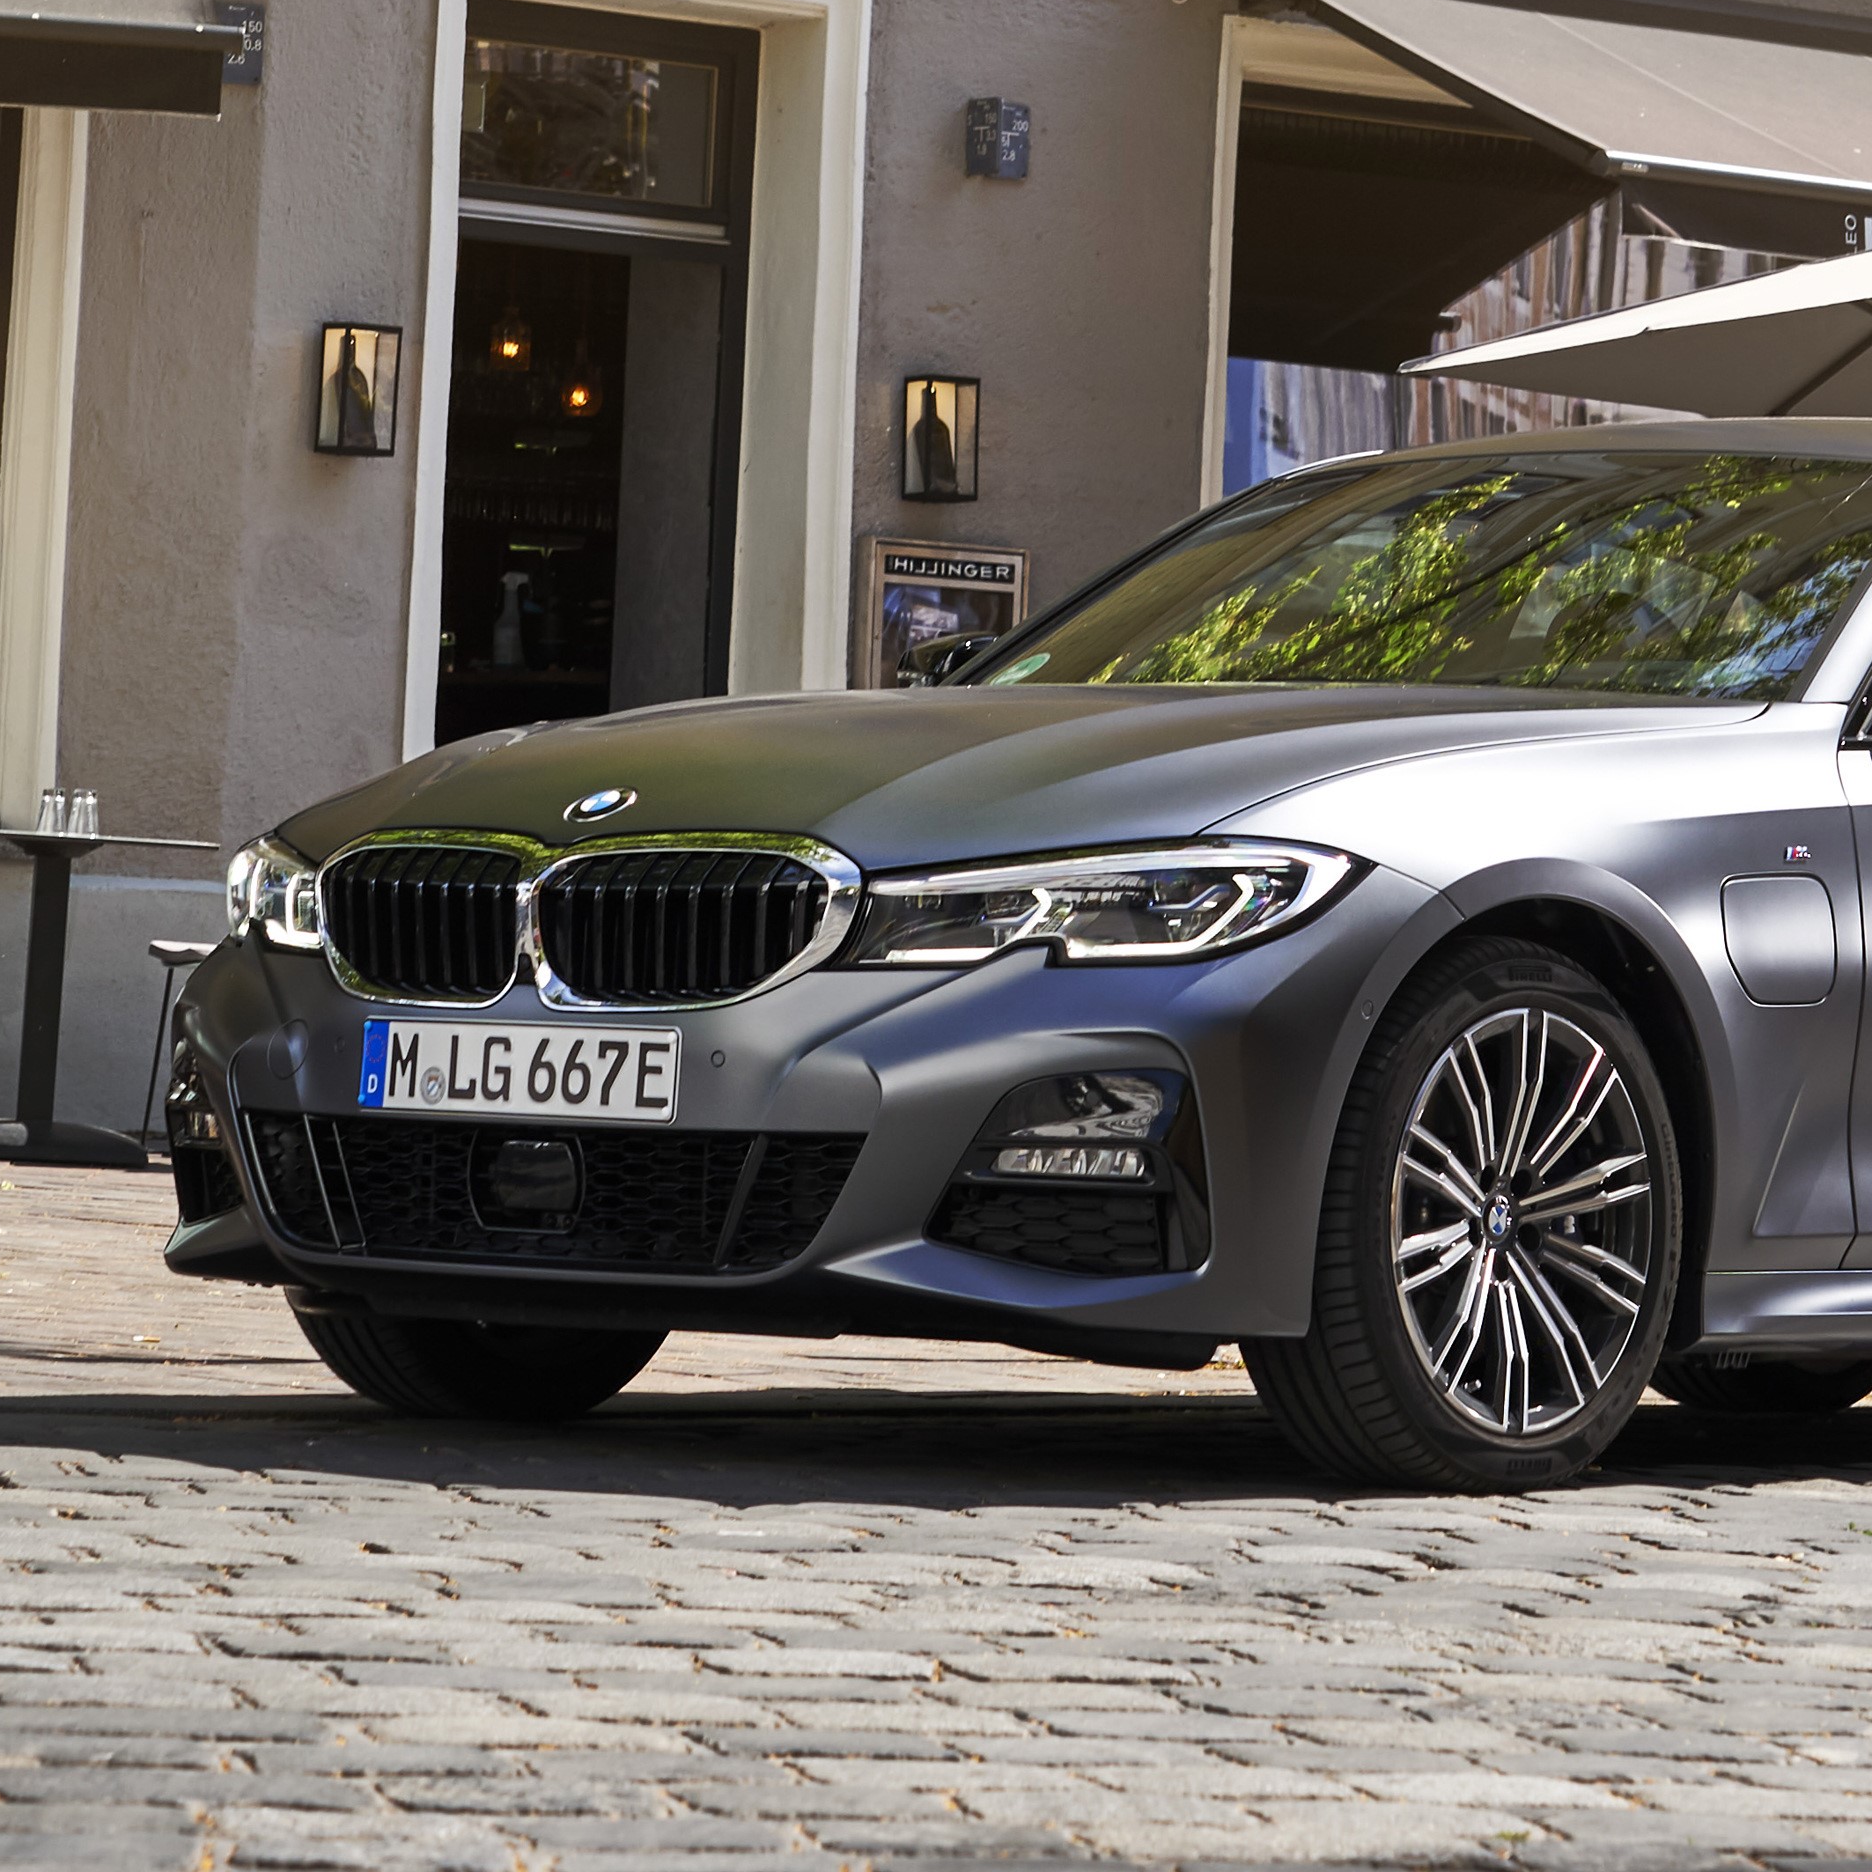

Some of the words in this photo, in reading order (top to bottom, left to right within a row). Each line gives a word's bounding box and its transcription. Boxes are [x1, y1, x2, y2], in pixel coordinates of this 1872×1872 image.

[242, 20, 263, 34] 150
[388, 1032, 420, 1098] M
[447, 1034, 512, 1102] LG
[528, 1037, 671, 1109] 667E
[367, 1074, 378, 1094] D
